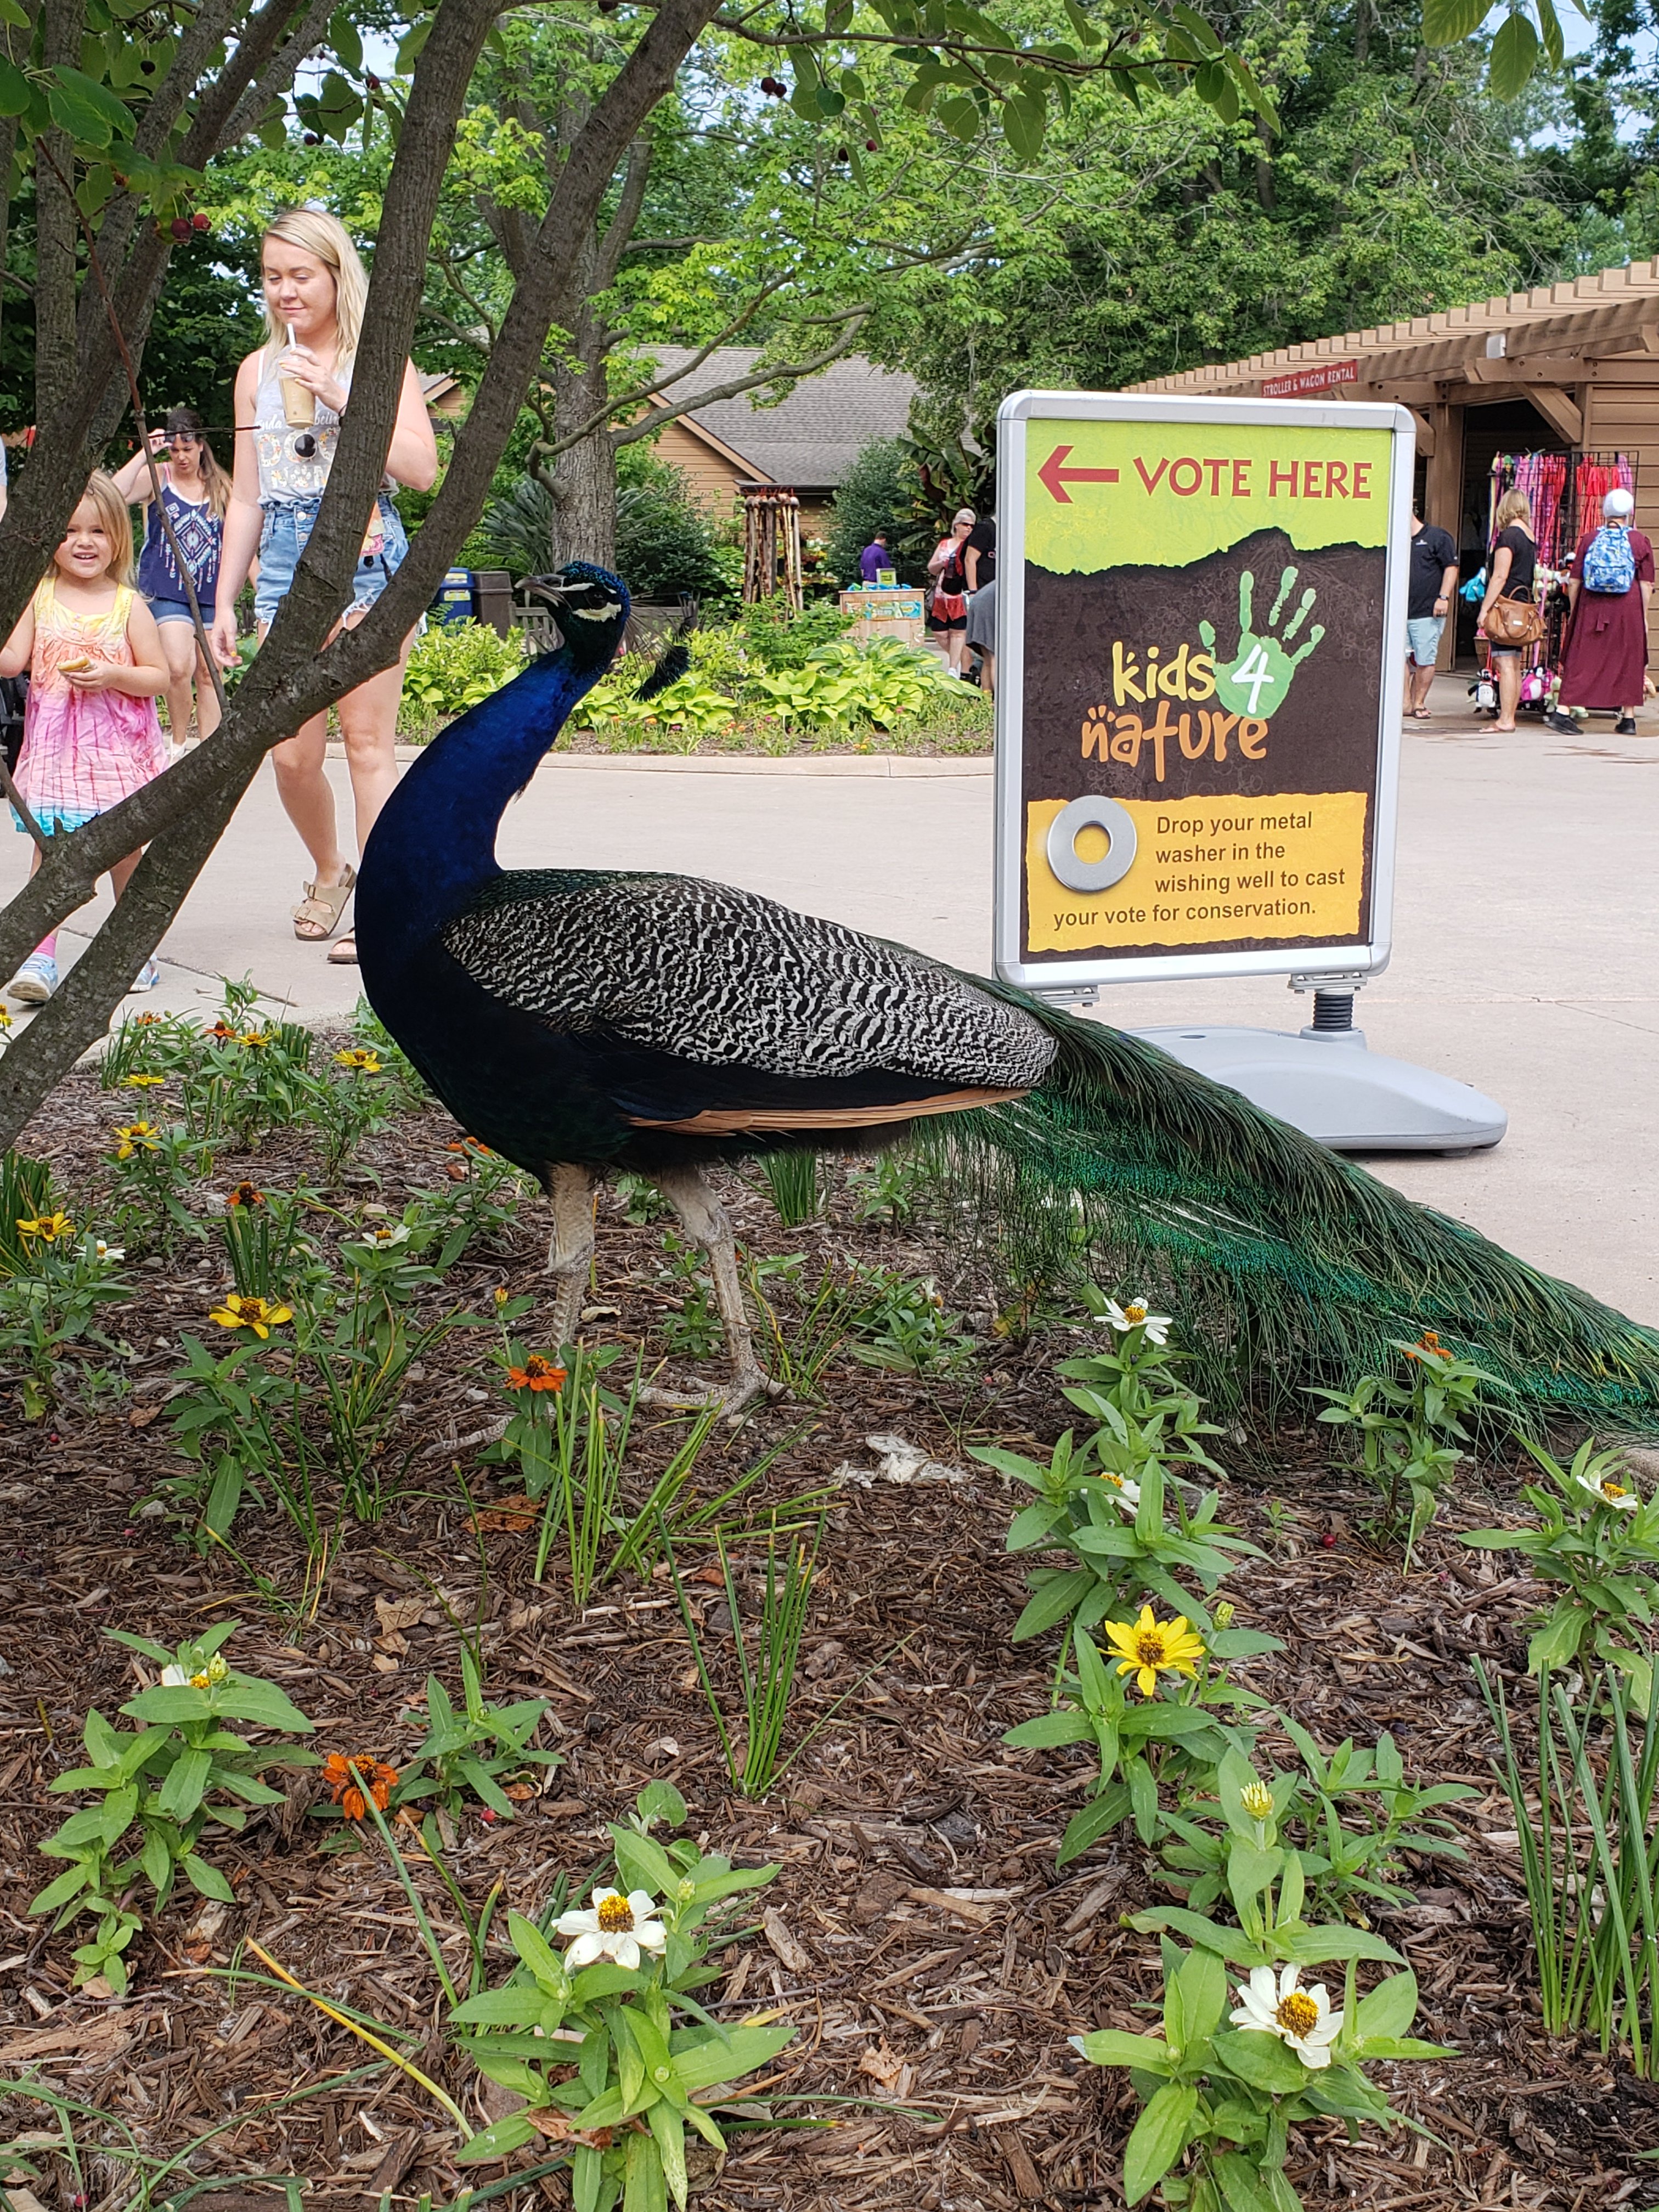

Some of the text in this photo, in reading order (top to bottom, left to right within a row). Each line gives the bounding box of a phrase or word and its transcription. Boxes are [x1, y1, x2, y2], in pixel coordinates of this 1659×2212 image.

[1263, 366, 1354, 397] STROLLER & WAGON RENTAL
[1132, 456, 1372, 499] VOTE HERE
[1112, 641, 1274, 714] kids 4
[1081, 700, 1268, 782] nature
[1157, 811, 1312, 837] Drop your metal
[1155, 842, 1285, 864] washer in the
[1154, 868, 1345, 894] wishing well to cast
[1053, 898, 1316, 932] your vote for conservation.
